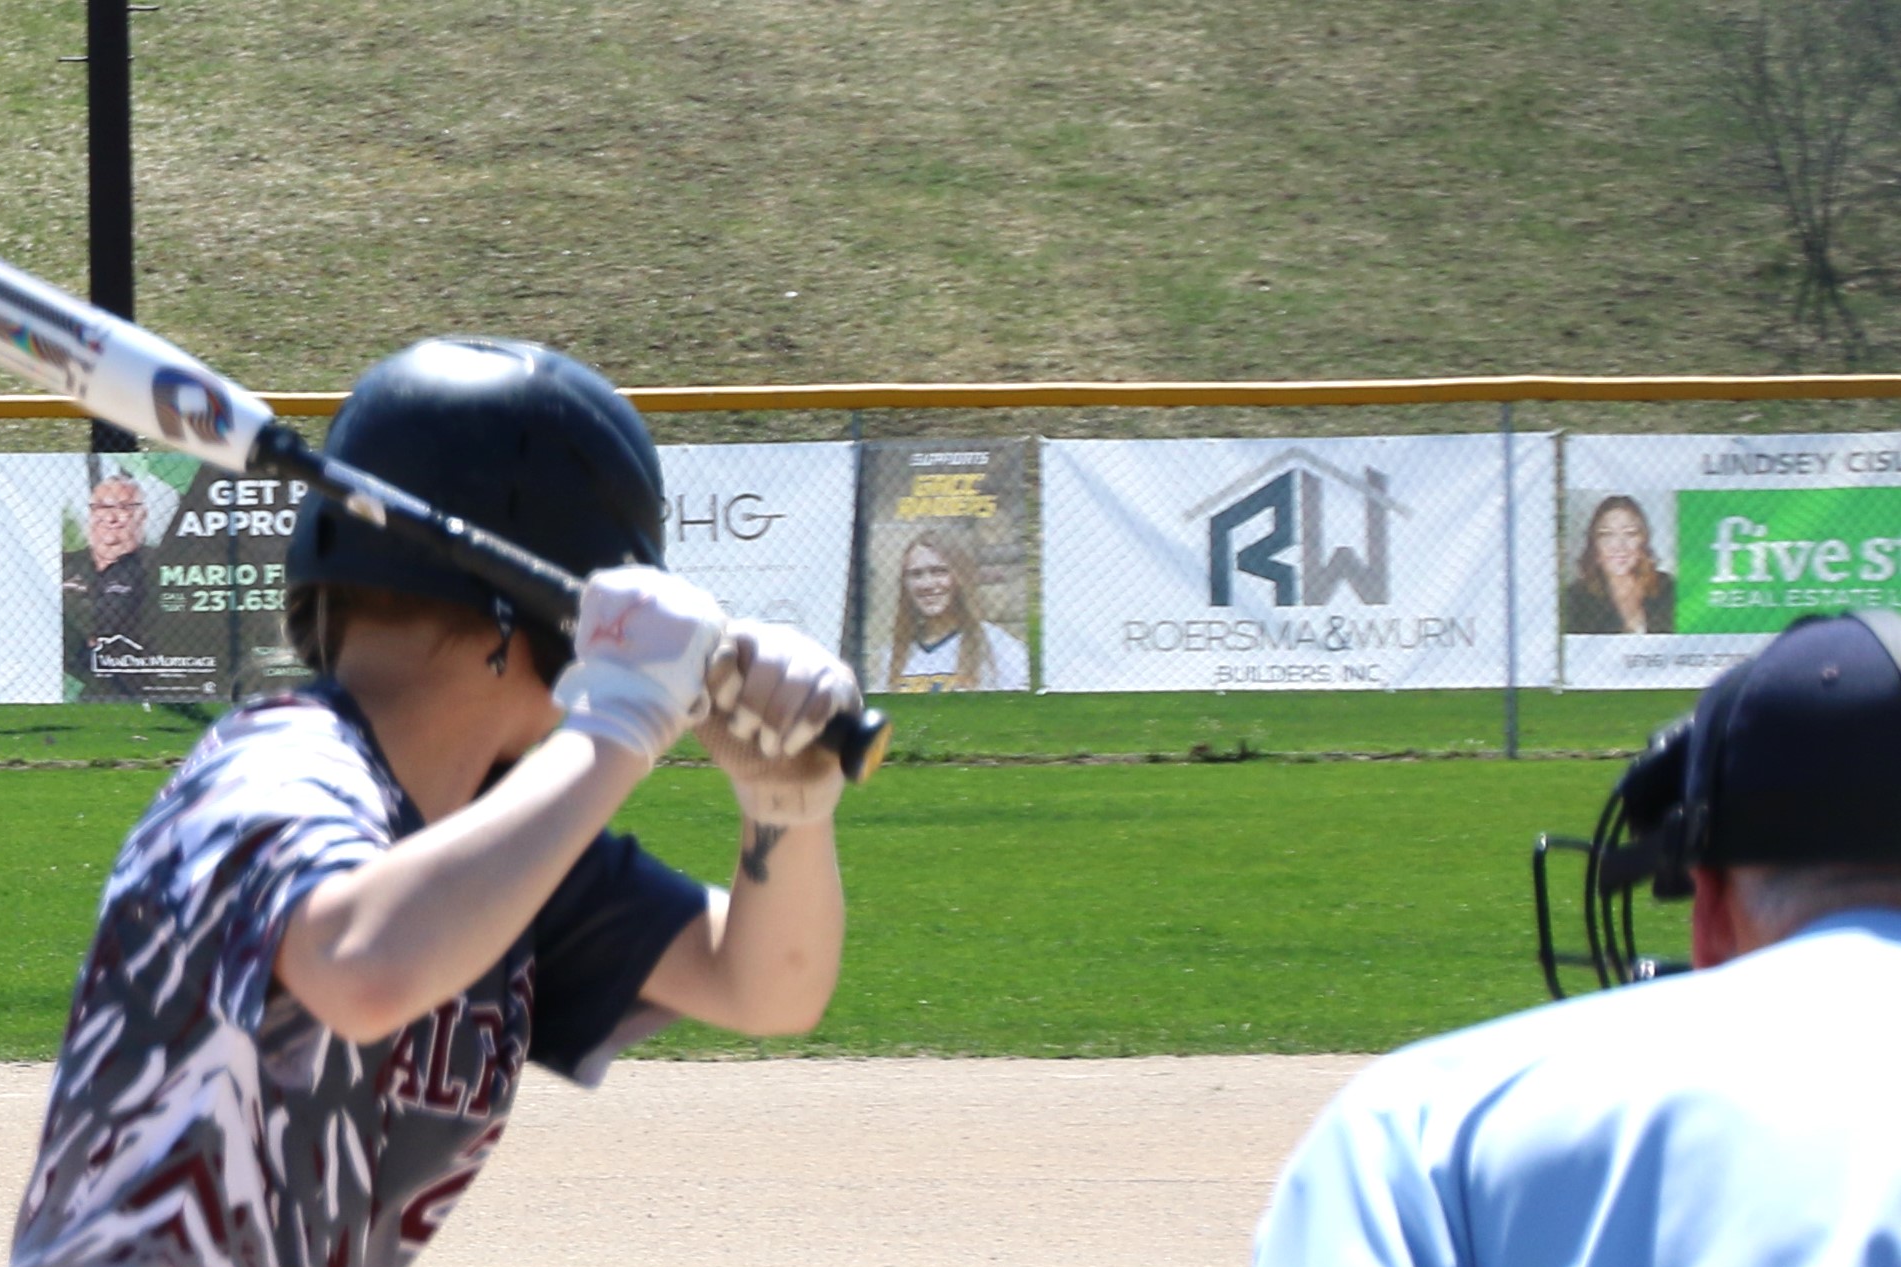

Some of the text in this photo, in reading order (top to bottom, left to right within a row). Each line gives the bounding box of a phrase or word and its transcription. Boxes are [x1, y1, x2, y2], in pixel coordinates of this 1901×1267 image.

[1703, 453, 1833, 475] LINDSEY
[208, 480, 281, 506] GET
[159, 564, 258, 586] MARIO
[1709, 589, 1779, 607] REAL
[1785, 588, 1883, 607] ESTATE
